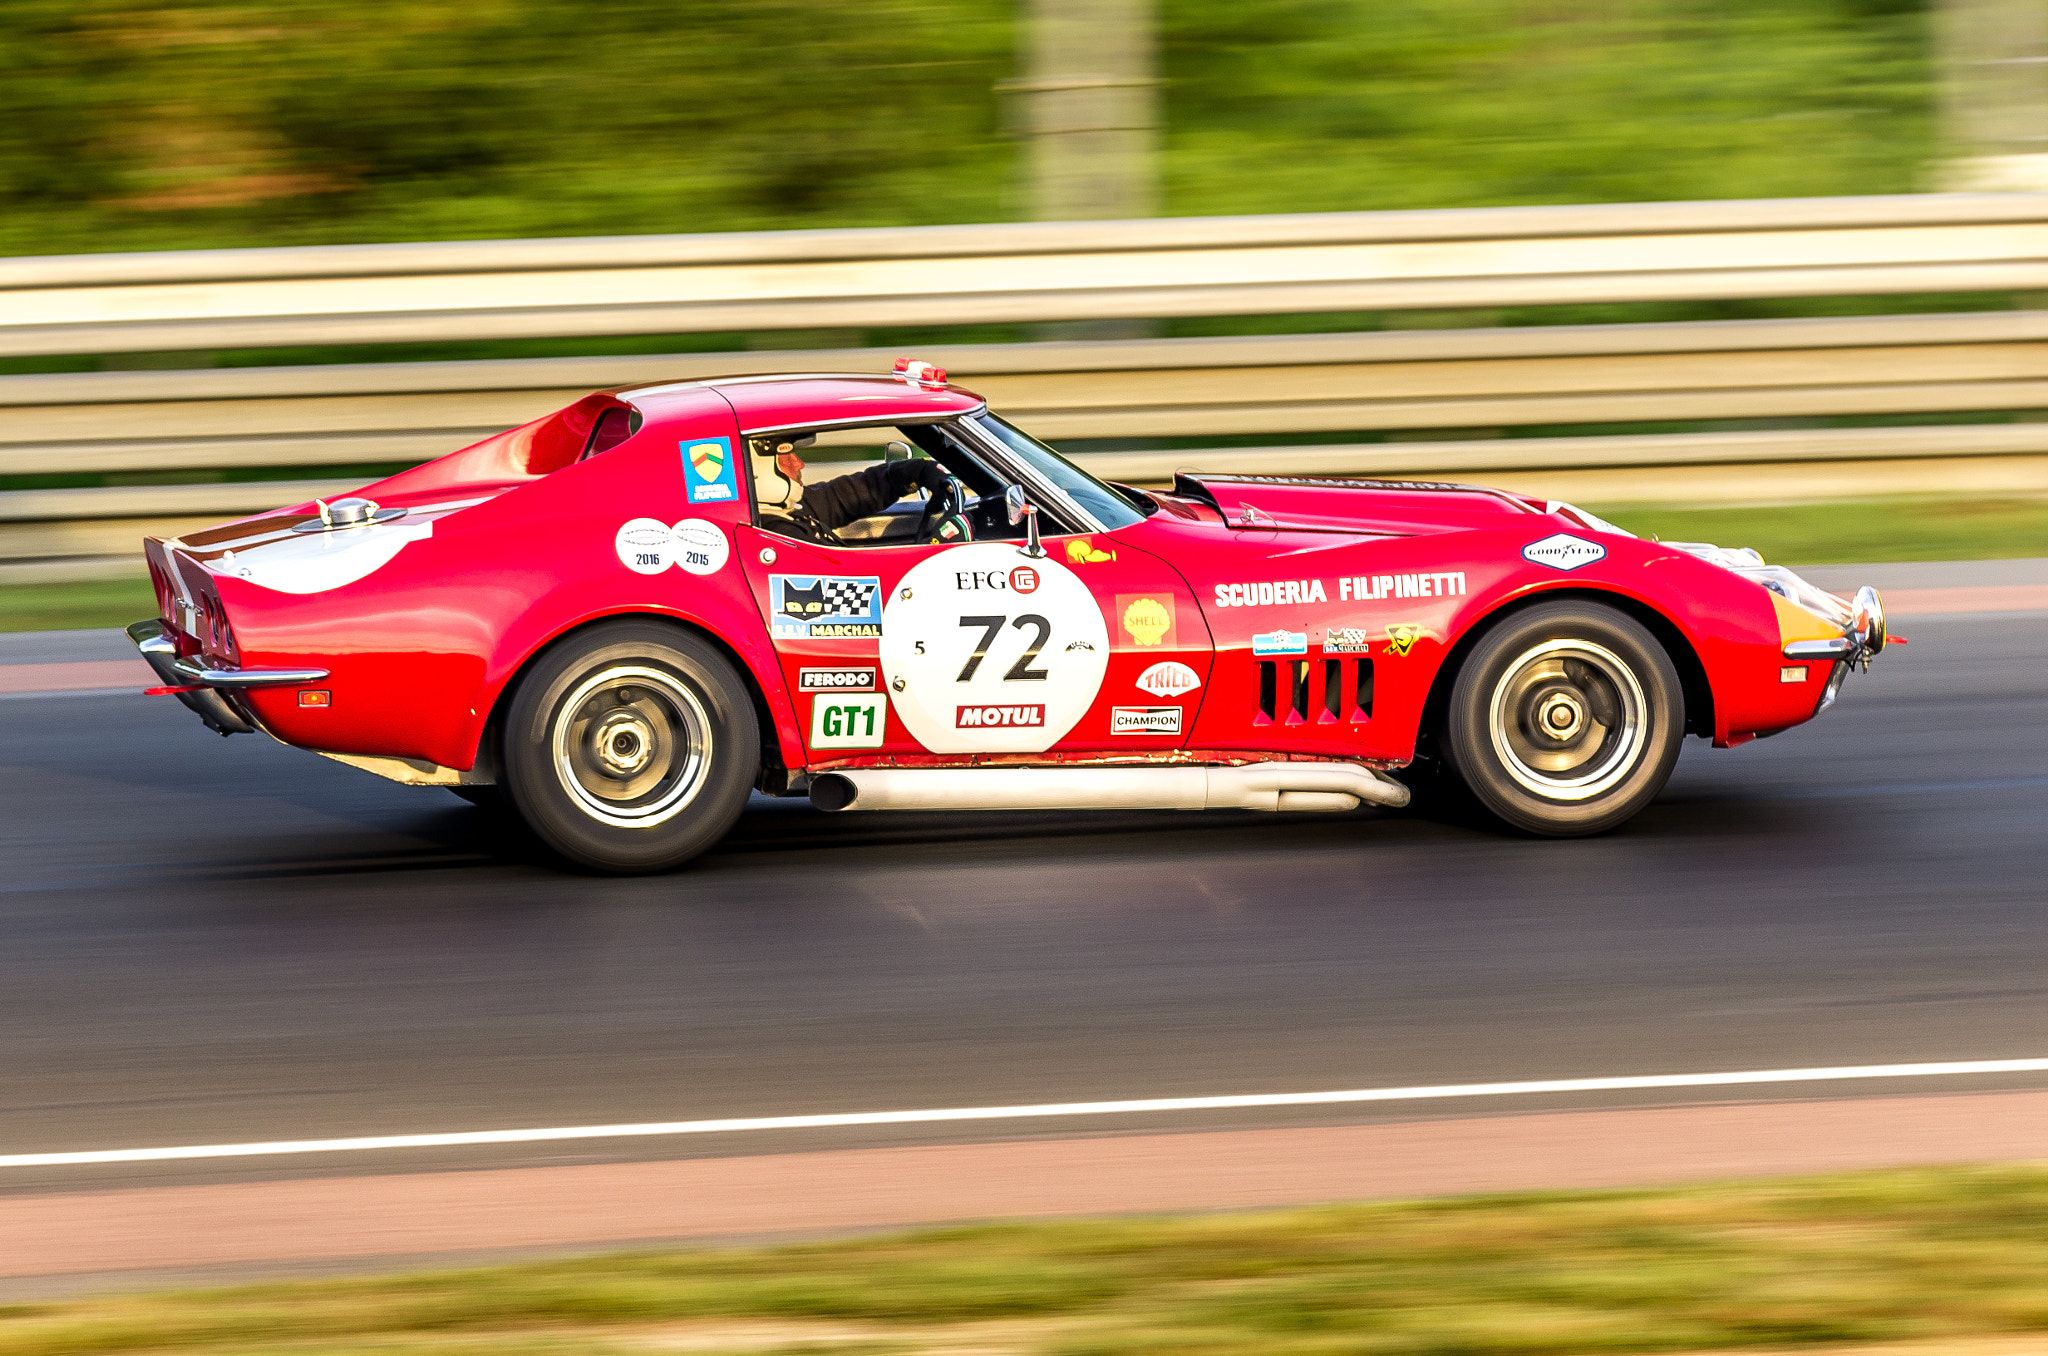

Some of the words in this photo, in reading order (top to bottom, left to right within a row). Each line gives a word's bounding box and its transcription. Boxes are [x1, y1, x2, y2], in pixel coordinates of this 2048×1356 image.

[636, 553, 660, 566] 2016
[686, 551, 710, 566] 2015
[955, 571, 1006, 590] EFG
[1214, 579, 1328, 608] SCUDERIA
[1339, 571, 1467, 602] FILIPINETTI
[1128, 615, 1166, 627] SHELL
[811, 624, 880, 637] MARCHAL
[914, 640, 926, 655] 5
[955, 613, 1052, 683] 72
[804, 673, 870, 687] FERODO
[1144, 665, 1192, 689] TRICO
[822, 705, 876, 737] GT1
[958, 706, 1042, 727] MOTUL
[1116, 715, 1178, 726] CHAMPION
